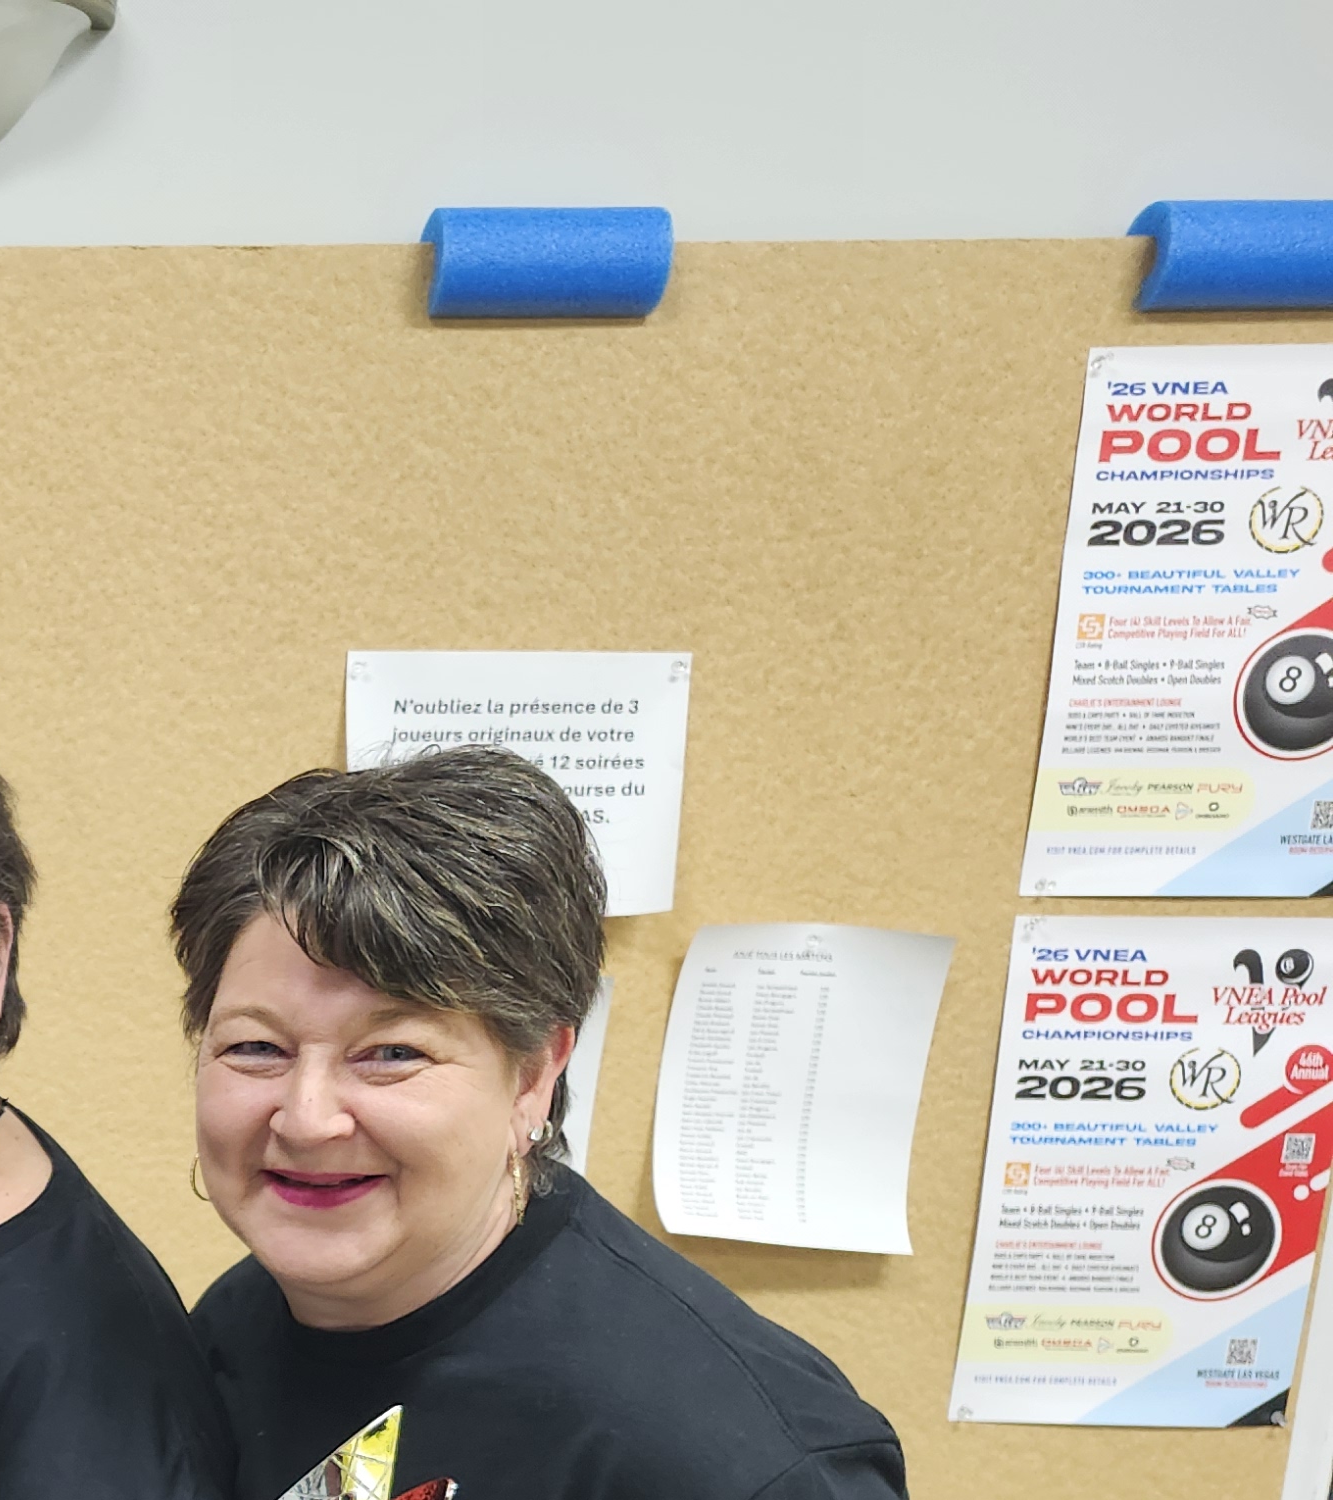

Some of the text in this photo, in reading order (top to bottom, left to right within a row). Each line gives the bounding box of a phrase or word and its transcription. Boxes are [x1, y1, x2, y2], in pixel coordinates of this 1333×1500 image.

[1107, 381, 1228, 396] '26 VNEA
[1106, 402, 1252, 422] WORLD
[1097, 428, 1282, 463] POOL
[1095, 468, 1275, 482] CHAMPIONSHIPS
[1091, 501, 1225, 514] MAY 21-30
[1087, 518, 1226, 547] 2026
[1128, 569, 1226, 580] BEAUTIFUL
[1233, 568, 1301, 579] VALLEY
[1082, 583, 1278, 595] TOURNAMENT TABLES
[1109, 616, 1128, 627] Four
[1143, 615, 1162, 627] Skill
[1163, 615, 1190, 627] Levels
[1192, 615, 1202, 626] To
[1203, 614, 1226, 627] Allow
[1227, 614, 1233, 626] A
[1107, 627, 1247, 641] Competitive Playing Field For ALL!
[1074, 660, 1095, 670] Team
[1130, 659, 1160, 671] Singles
[1195, 659, 1225, 671] Singles
[1072, 674, 1221, 687] Mixed Scotch Doubles Open Doubles
[1278, 665, 1302, 693] 8
[393, 697, 639, 719] N'oubliez la présence de 3
[391, 727, 635, 746] joueurs originaux de votre
[550, 755, 571, 770] 12
[575, 753, 646, 771] soirées
[563, 780, 646, 797] ourse du
[1032, 947, 1148, 962] '26 VNEA
[1031, 968, 1169, 987] WORLD
[1211, 985, 1328, 1007] VNEA Pool
[1023, 992, 1198, 1024] POOL
[1222, 1006, 1306, 1031] Leagues
[1022, 1029, 1193, 1042] CHAMPIONSHIPS
[1018, 1059, 1146, 1072] MAY 21-30
[1015, 1076, 1146, 1101] 2026
[1053, 1121, 1147, 1133] BEAUTIFUL
[1154, 1122, 1219, 1133] VALLEY
[1009, 1135, 1197, 1147] TOURNAMENT TABLES
[1195, 1214, 1217, 1239] 8
